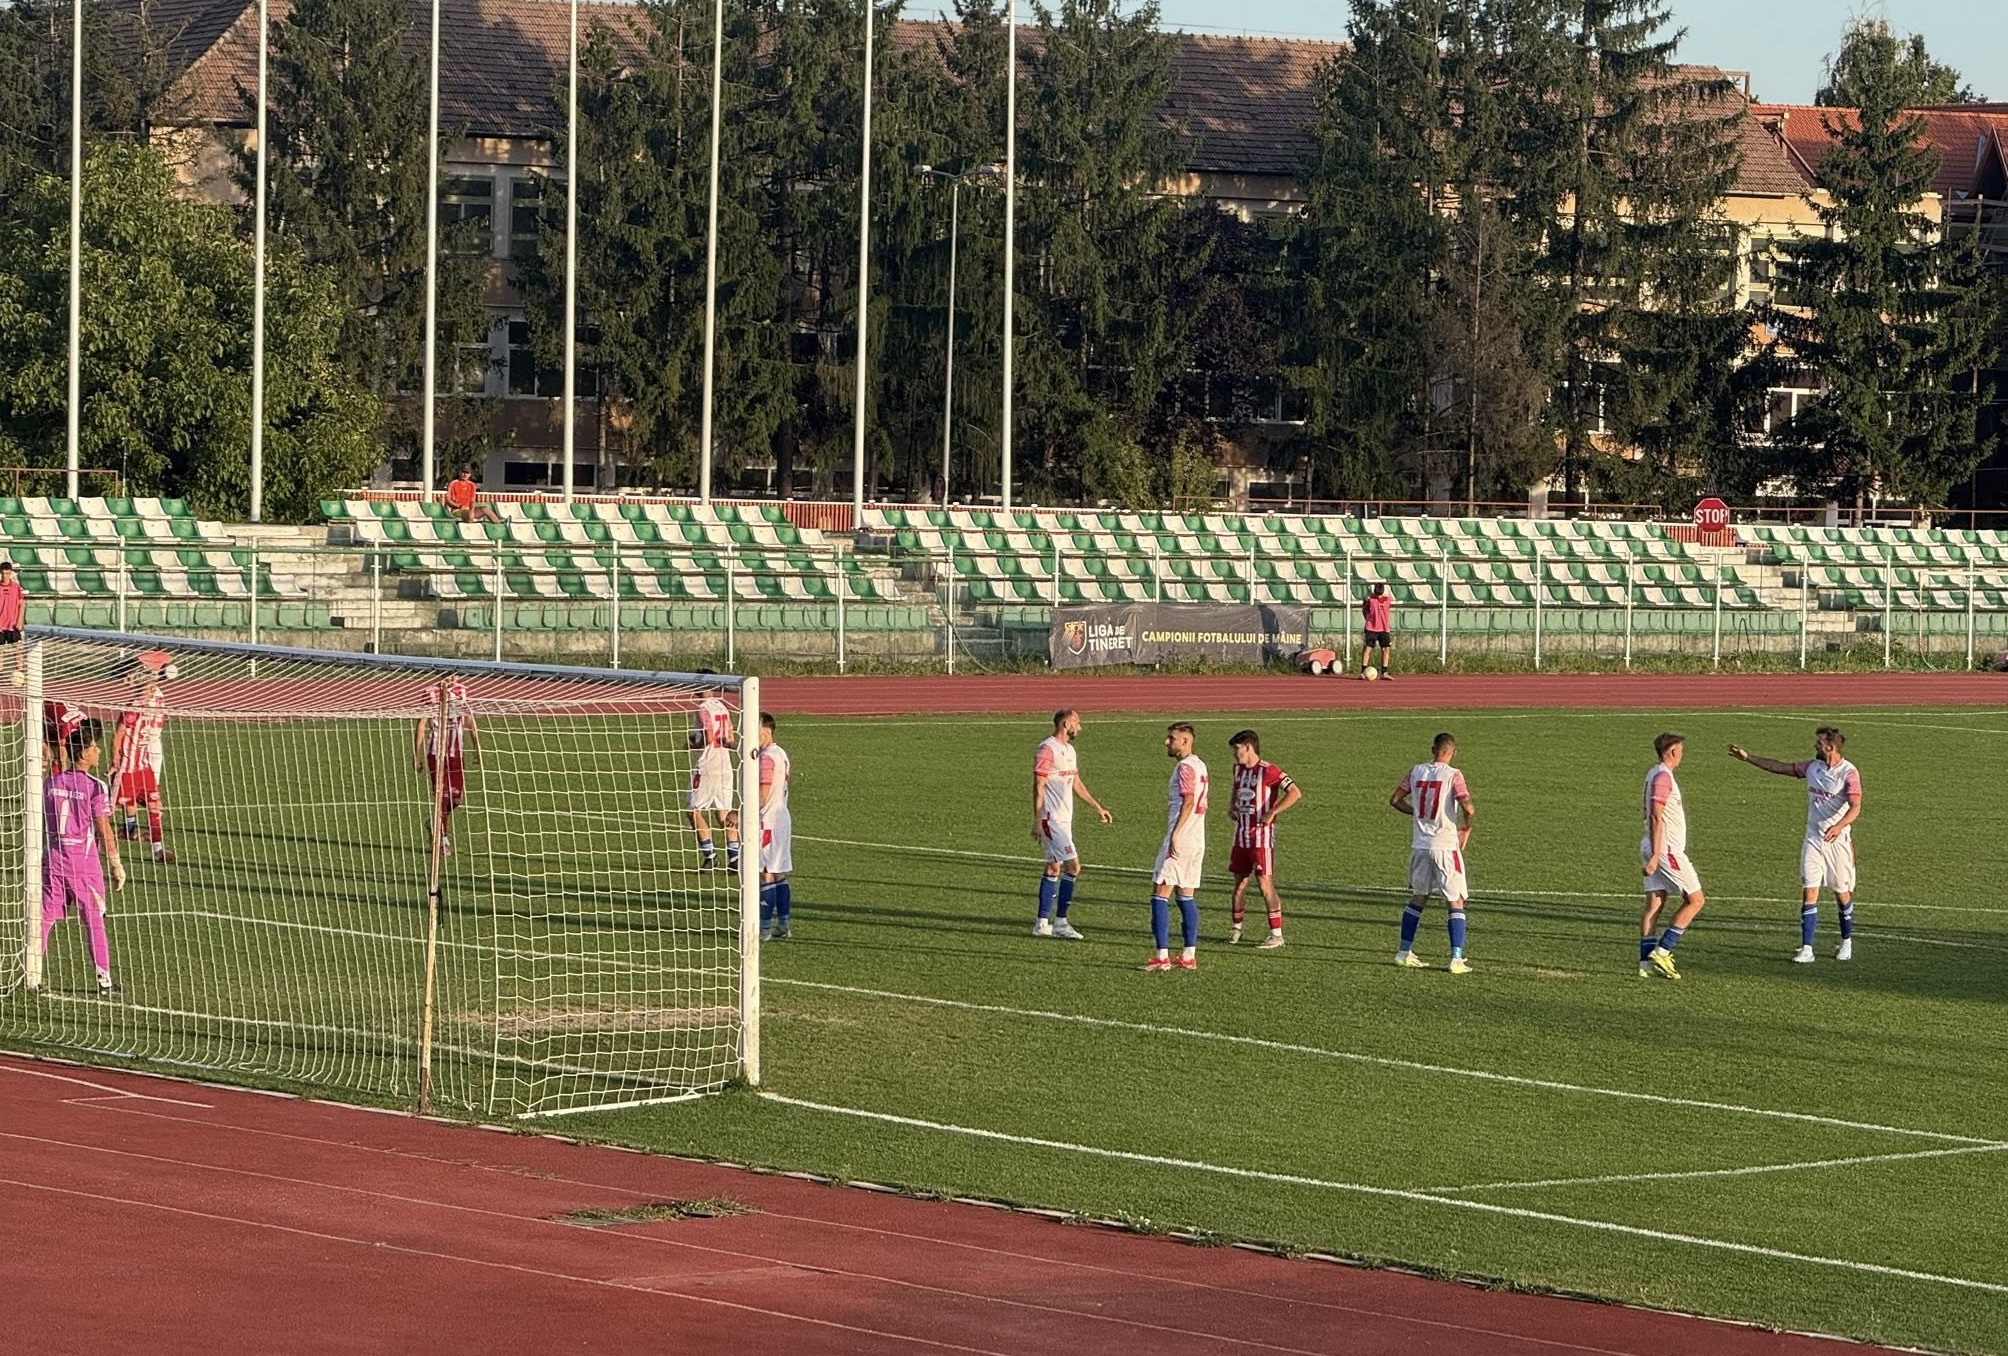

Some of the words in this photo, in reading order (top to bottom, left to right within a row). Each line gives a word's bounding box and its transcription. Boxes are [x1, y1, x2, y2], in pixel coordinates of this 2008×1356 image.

[1695, 508, 1728, 524] STOP
[1088, 624, 1114, 638] LIGA
[1114, 625, 1126, 636] DE
[1141, 630, 1196, 643] CAMPIONII
[1197, 632, 1256, 644] FOTBALULUI
[1258, 633, 1270, 645] DE
[1088, 636, 1134, 652] TINERET
[1415, 780, 1443, 820] 77
